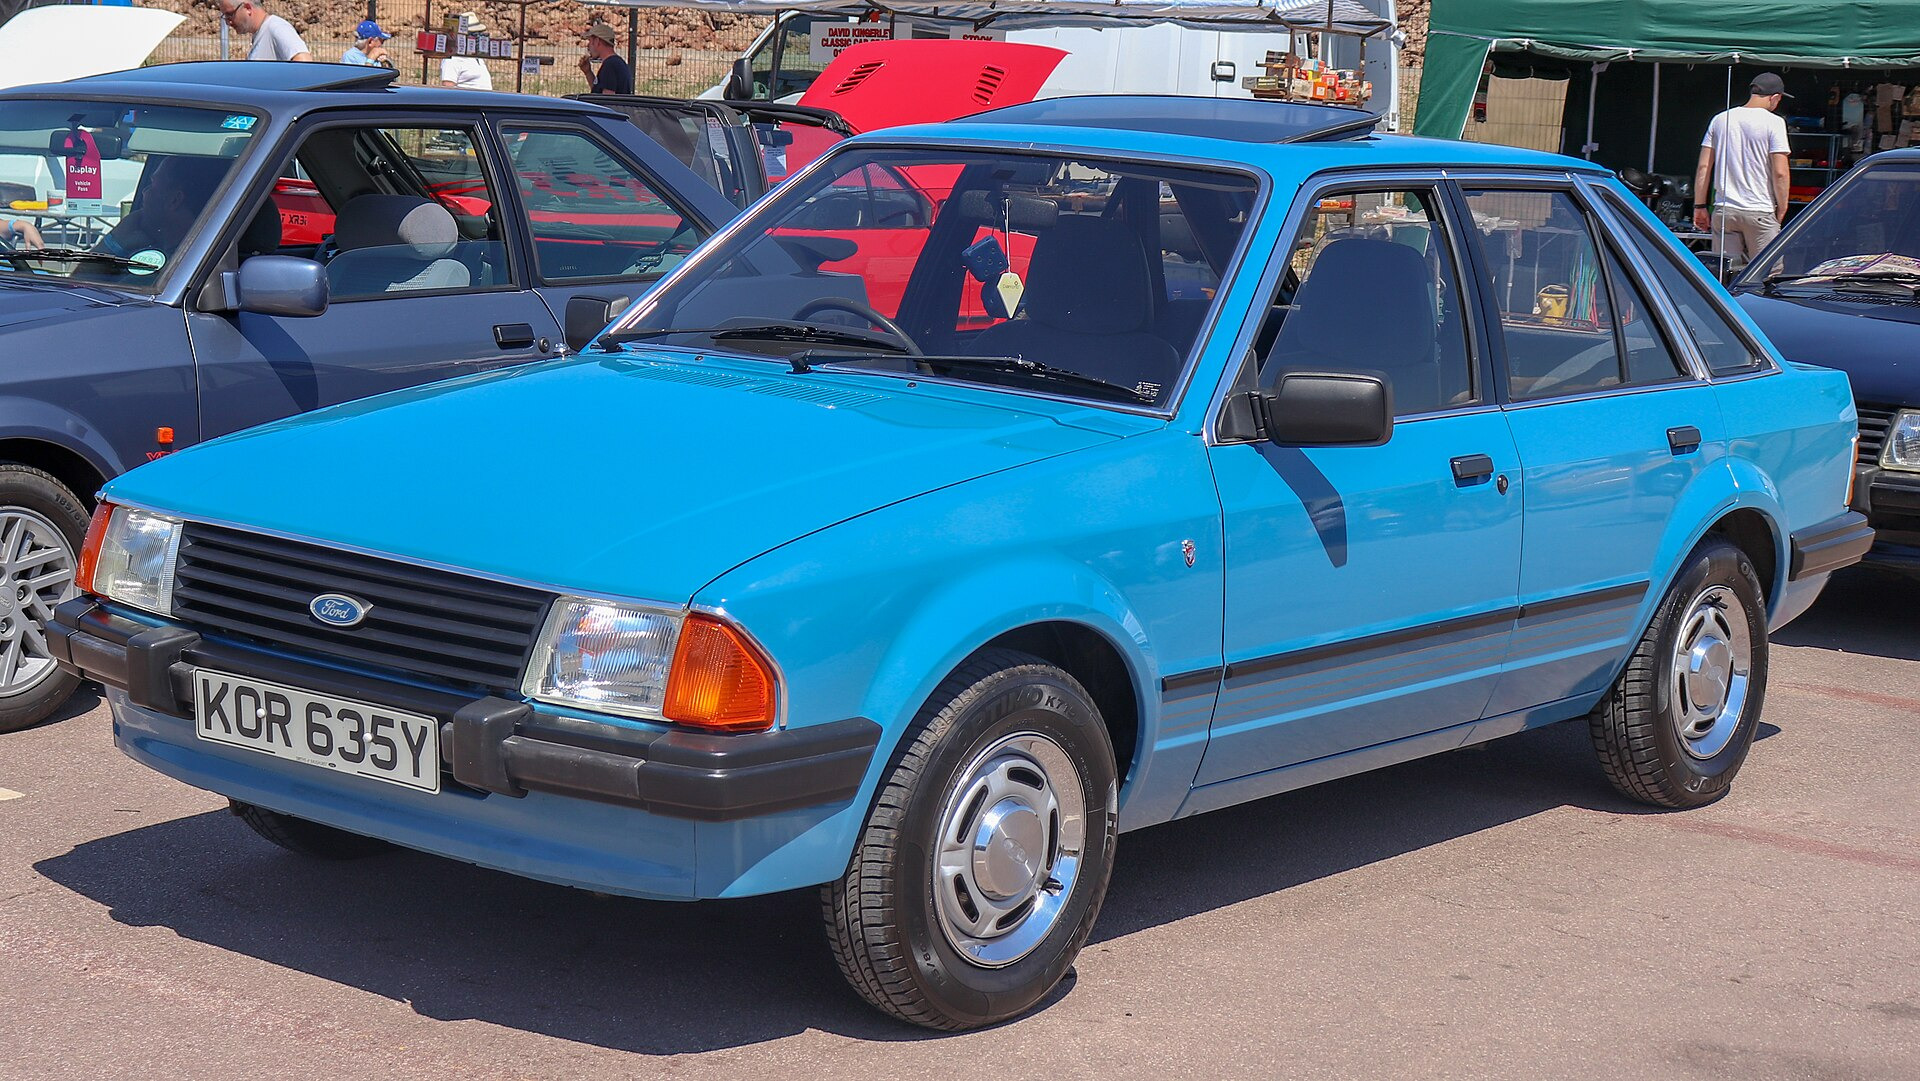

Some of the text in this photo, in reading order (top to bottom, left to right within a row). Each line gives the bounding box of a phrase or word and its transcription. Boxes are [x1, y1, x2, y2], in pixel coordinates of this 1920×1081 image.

[828, 28, 850, 37] DAVID
[821, 38, 852, 47] CLASSIC
[321, 599, 351, 619] Ford
[202, 678, 428, 778] KOR 635Y
